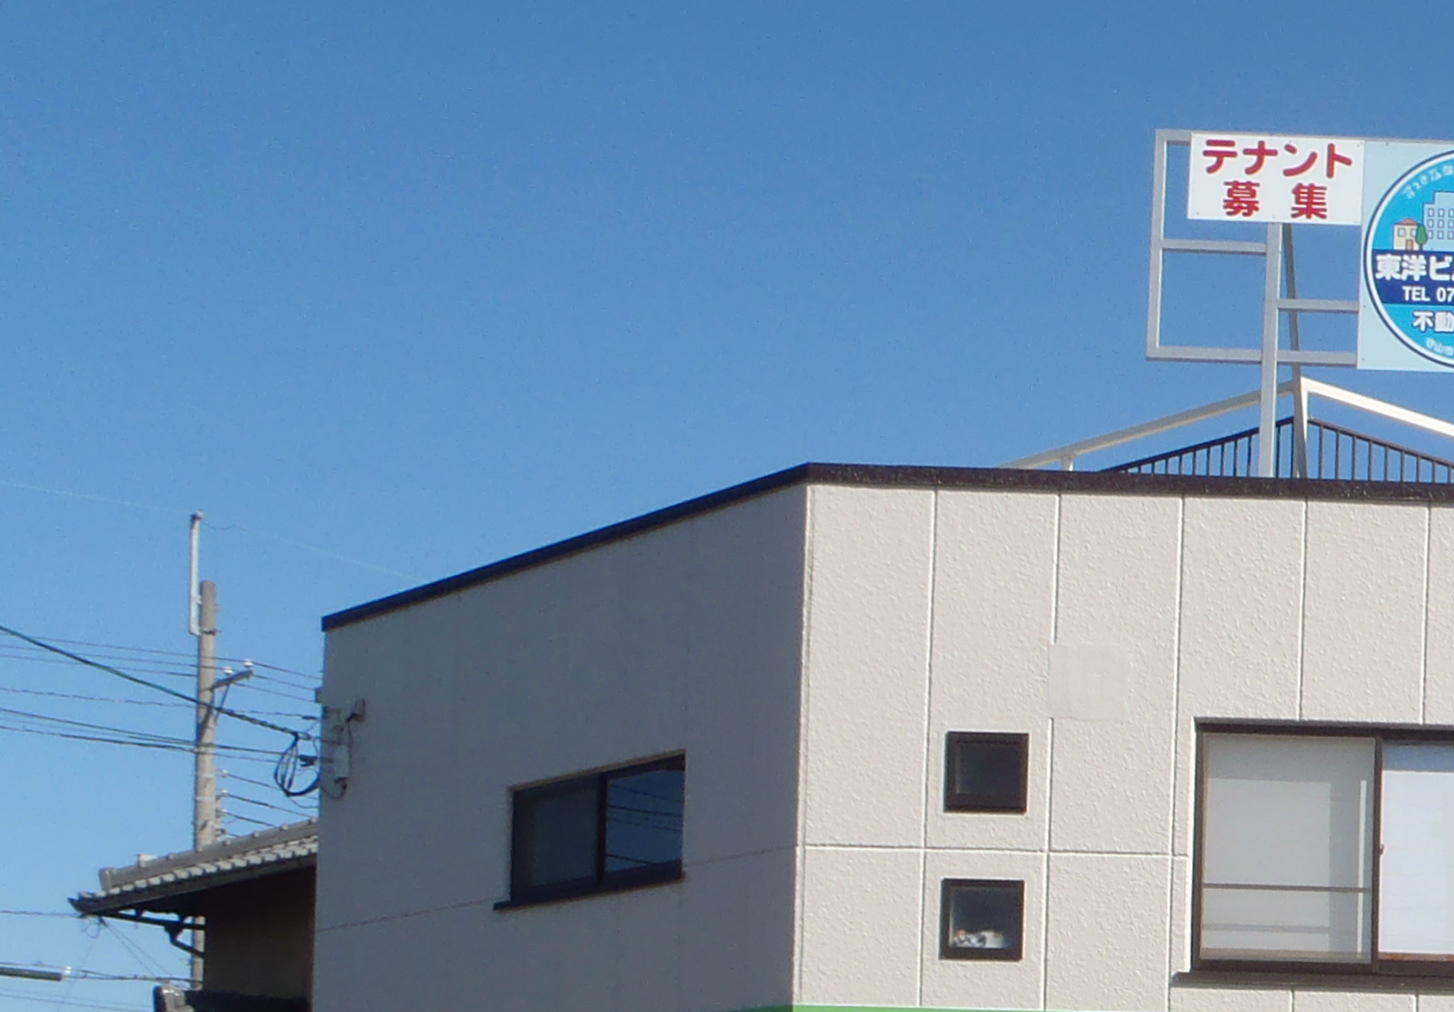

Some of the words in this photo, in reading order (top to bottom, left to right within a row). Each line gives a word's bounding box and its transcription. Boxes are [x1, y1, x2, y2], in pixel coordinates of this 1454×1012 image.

[1202, 139, 1352, 179] テナント
[1222, 180, 1328, 220] 募集
[1402, 286, 1431, 302] TEL
